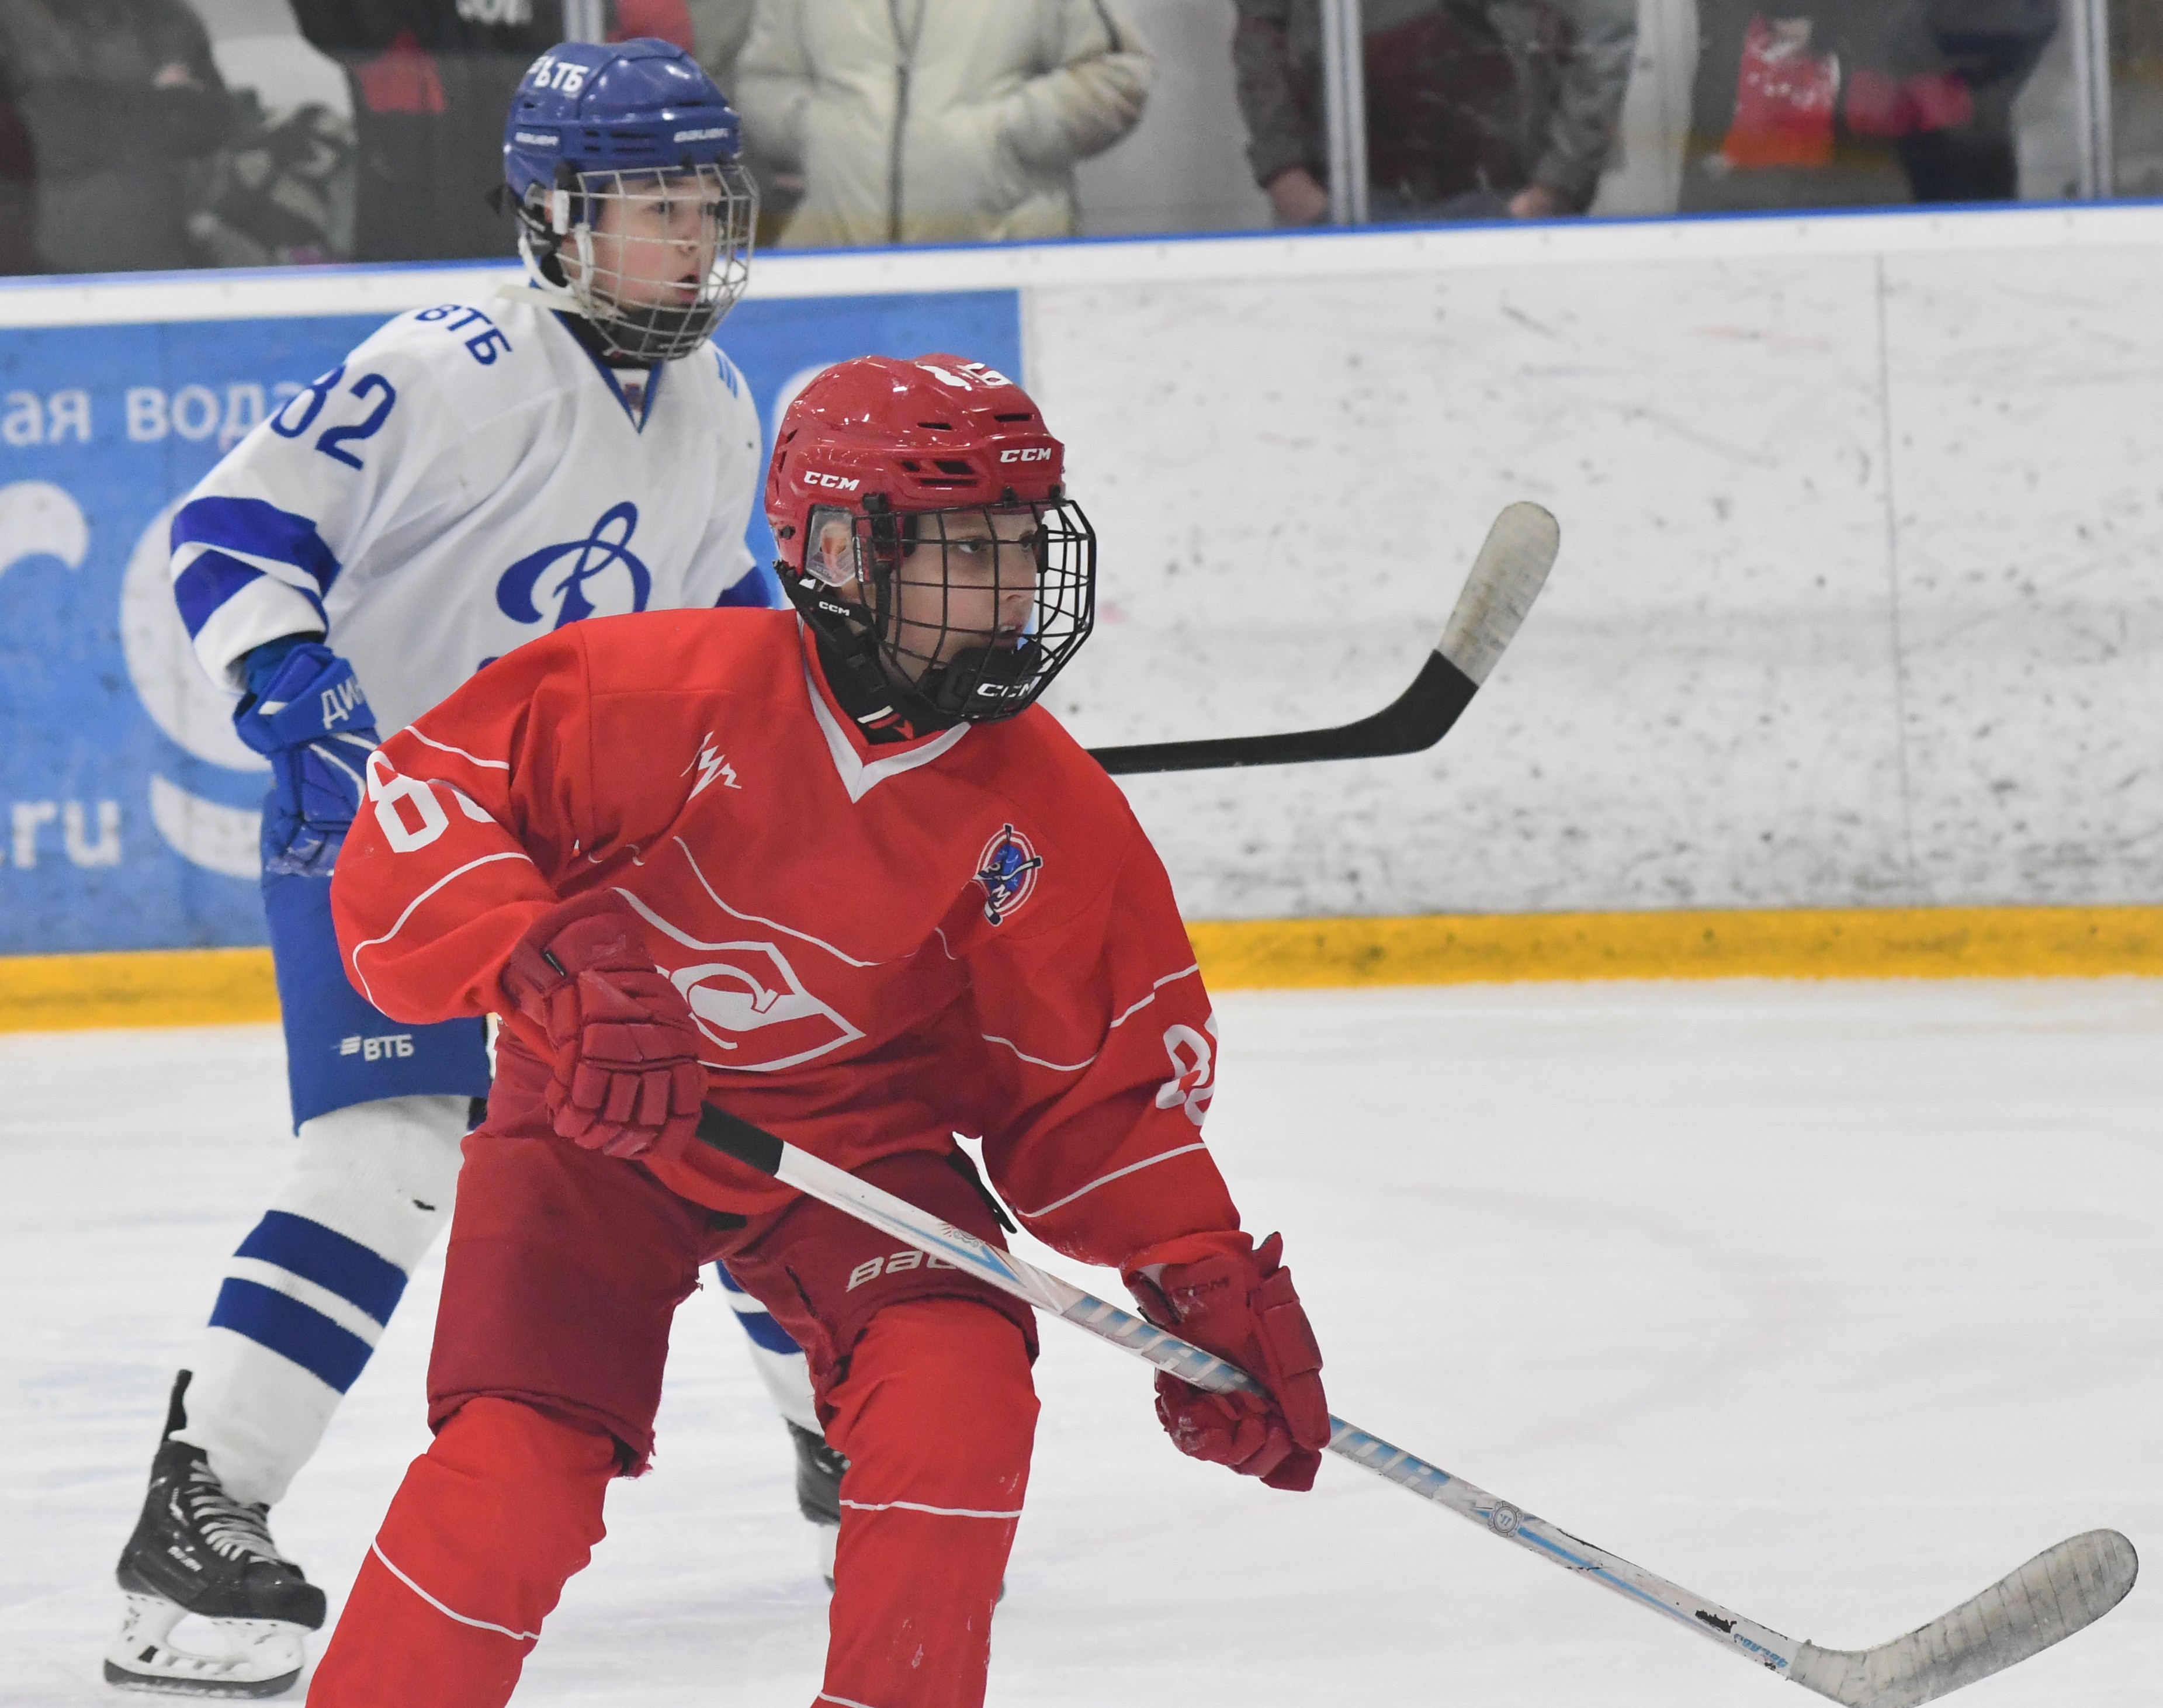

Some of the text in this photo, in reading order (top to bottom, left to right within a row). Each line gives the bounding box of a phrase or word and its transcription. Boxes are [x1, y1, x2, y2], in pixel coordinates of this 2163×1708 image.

[414, 309, 512, 365] ВТБ
[2, 383, 304, 453] ая вод
[271, 365, 396, 471] 82
[1000, 448, 1051, 463] CCM
[804, 470, 860, 491] CCM
[819, 601, 850, 616] CCM
[977, 675, 1042, 698] CCM
[366, 750, 497, 853] 8
[363, 1033, 414, 1062] ВТБ
